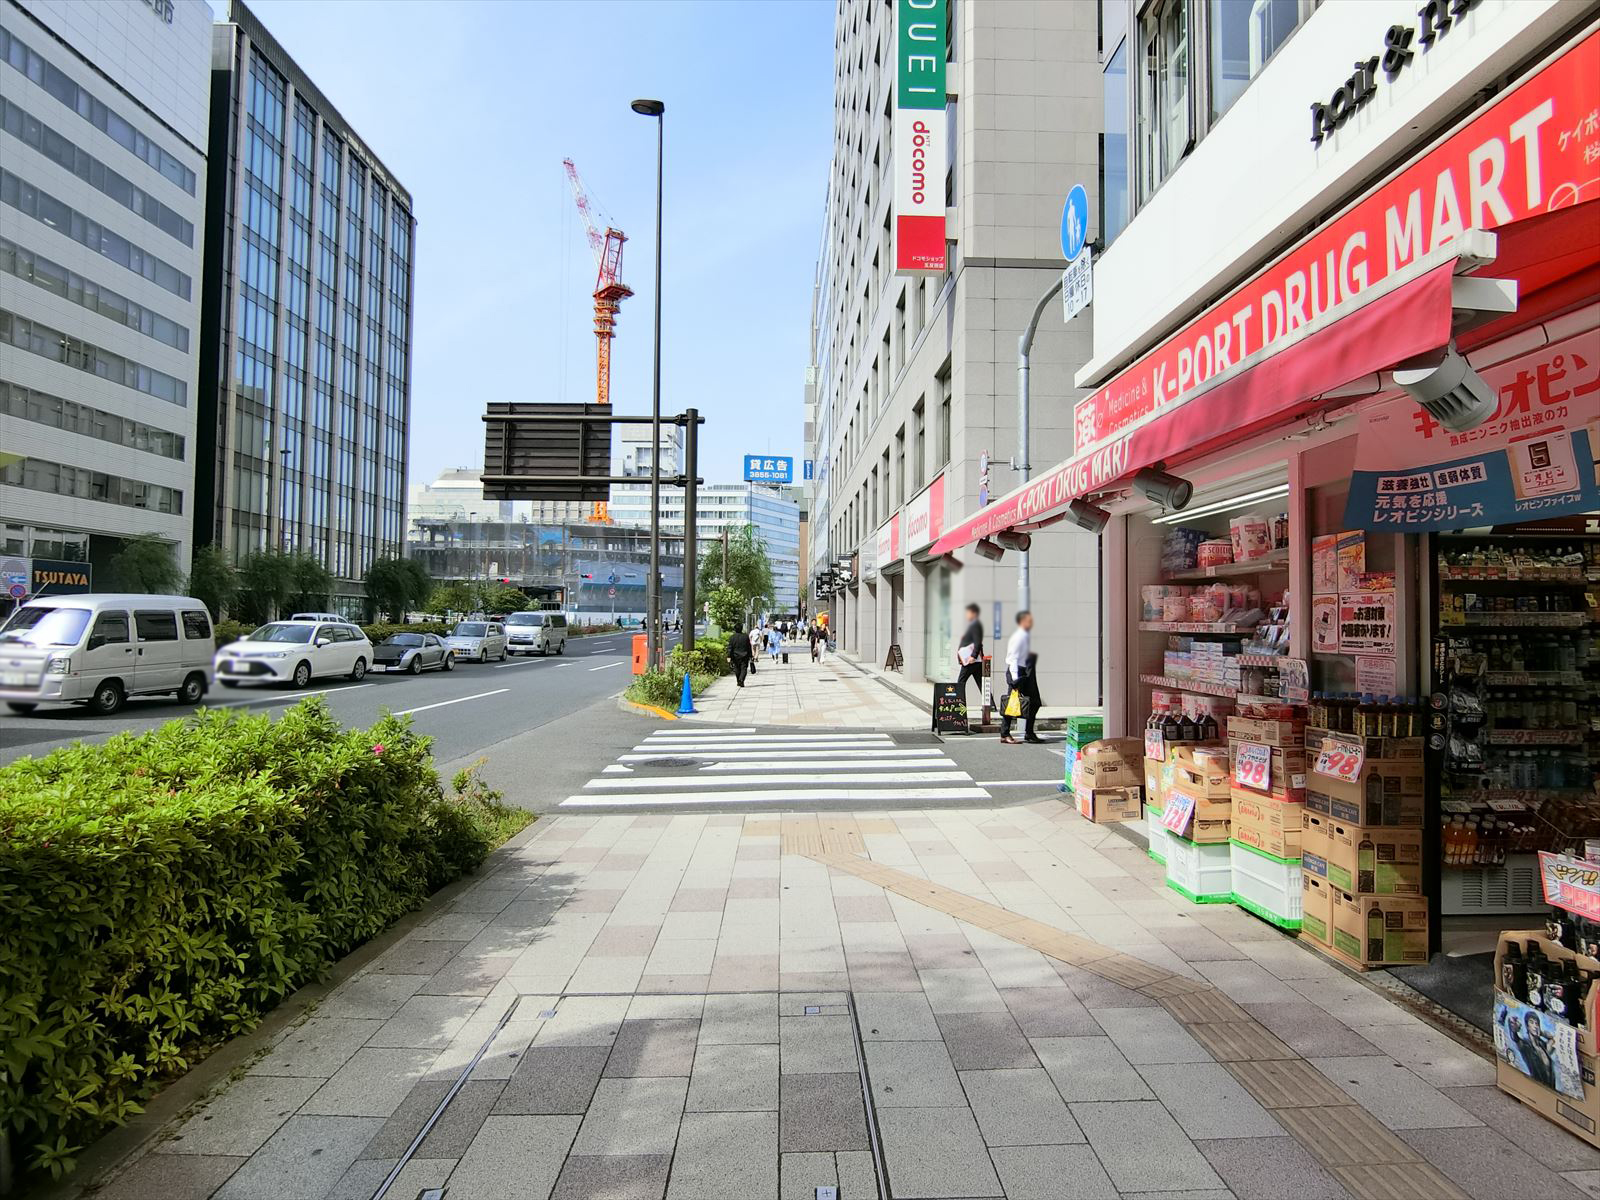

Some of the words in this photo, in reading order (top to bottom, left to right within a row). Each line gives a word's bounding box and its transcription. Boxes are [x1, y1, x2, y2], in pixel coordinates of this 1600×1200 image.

[1382, 25, 1414, 73] &
[912, 121, 930, 204] docomo
[1153, 304, 1252, 411] K-PORT
[1261, 231, 1368, 348] DRUG
[1385, 97, 1553, 278] MART
[1108, 383, 1140, 416] Medicine
[1141, 376, 1149, 396] &
[750, 459, 787, 471] 貸広告
[1016, 477, 1056, 519] K-PORT
[1055, 459, 1088, 502] DRUG
[1091, 432, 1135, 486] MART
[1373, 502, 1484, 523] レオピンシリーズ
[1375, 490, 1448, 510] 元気を応援
[908, 511, 927, 539] docomo
[35, 570, 88, 586] TSUTAYA
[1241, 760, 1264, 784] 98
[1327, 752, 1358, 775] 98
